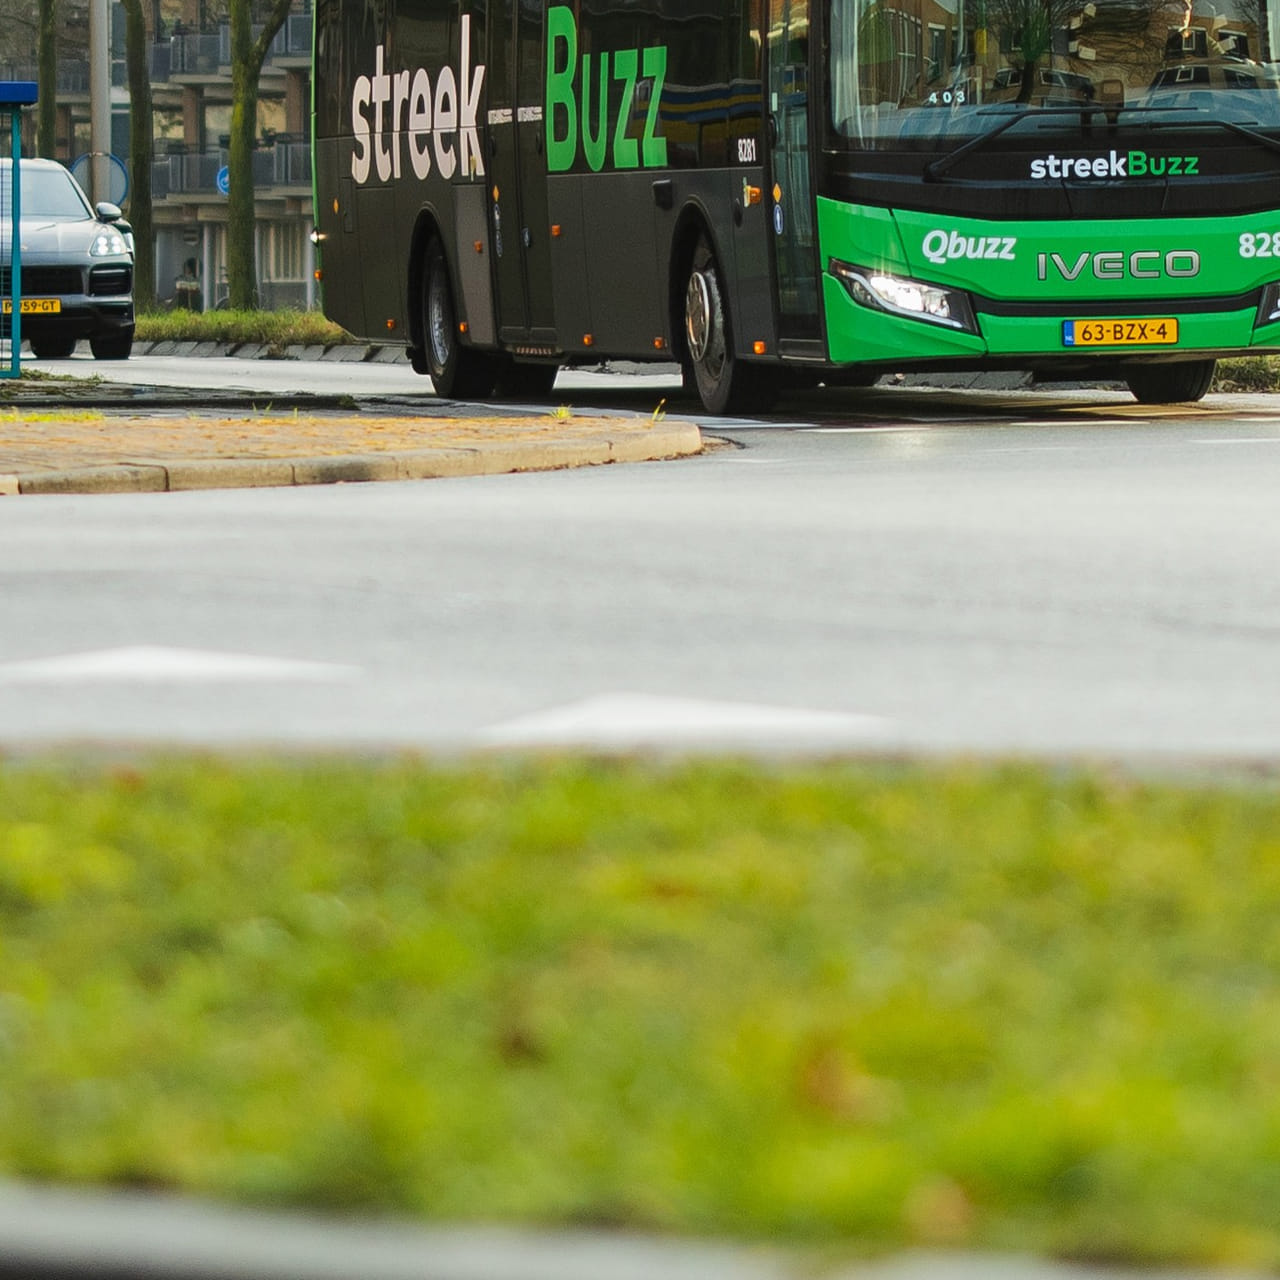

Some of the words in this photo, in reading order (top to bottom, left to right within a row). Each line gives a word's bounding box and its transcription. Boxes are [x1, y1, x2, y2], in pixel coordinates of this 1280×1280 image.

[351, 14, 486, 185] streek
[546, 5, 668, 172] Buzz
[737, 138, 757, 162] 8281
[1030, 150, 1199, 179] streekBuzz
[922, 229, 1017, 264] Qbuzz
[1037, 250, 1201, 281] IVECO
[4, 300, 57, 311] P59-GT
[1081, 323, 1168, 341] 63-BZX-4
